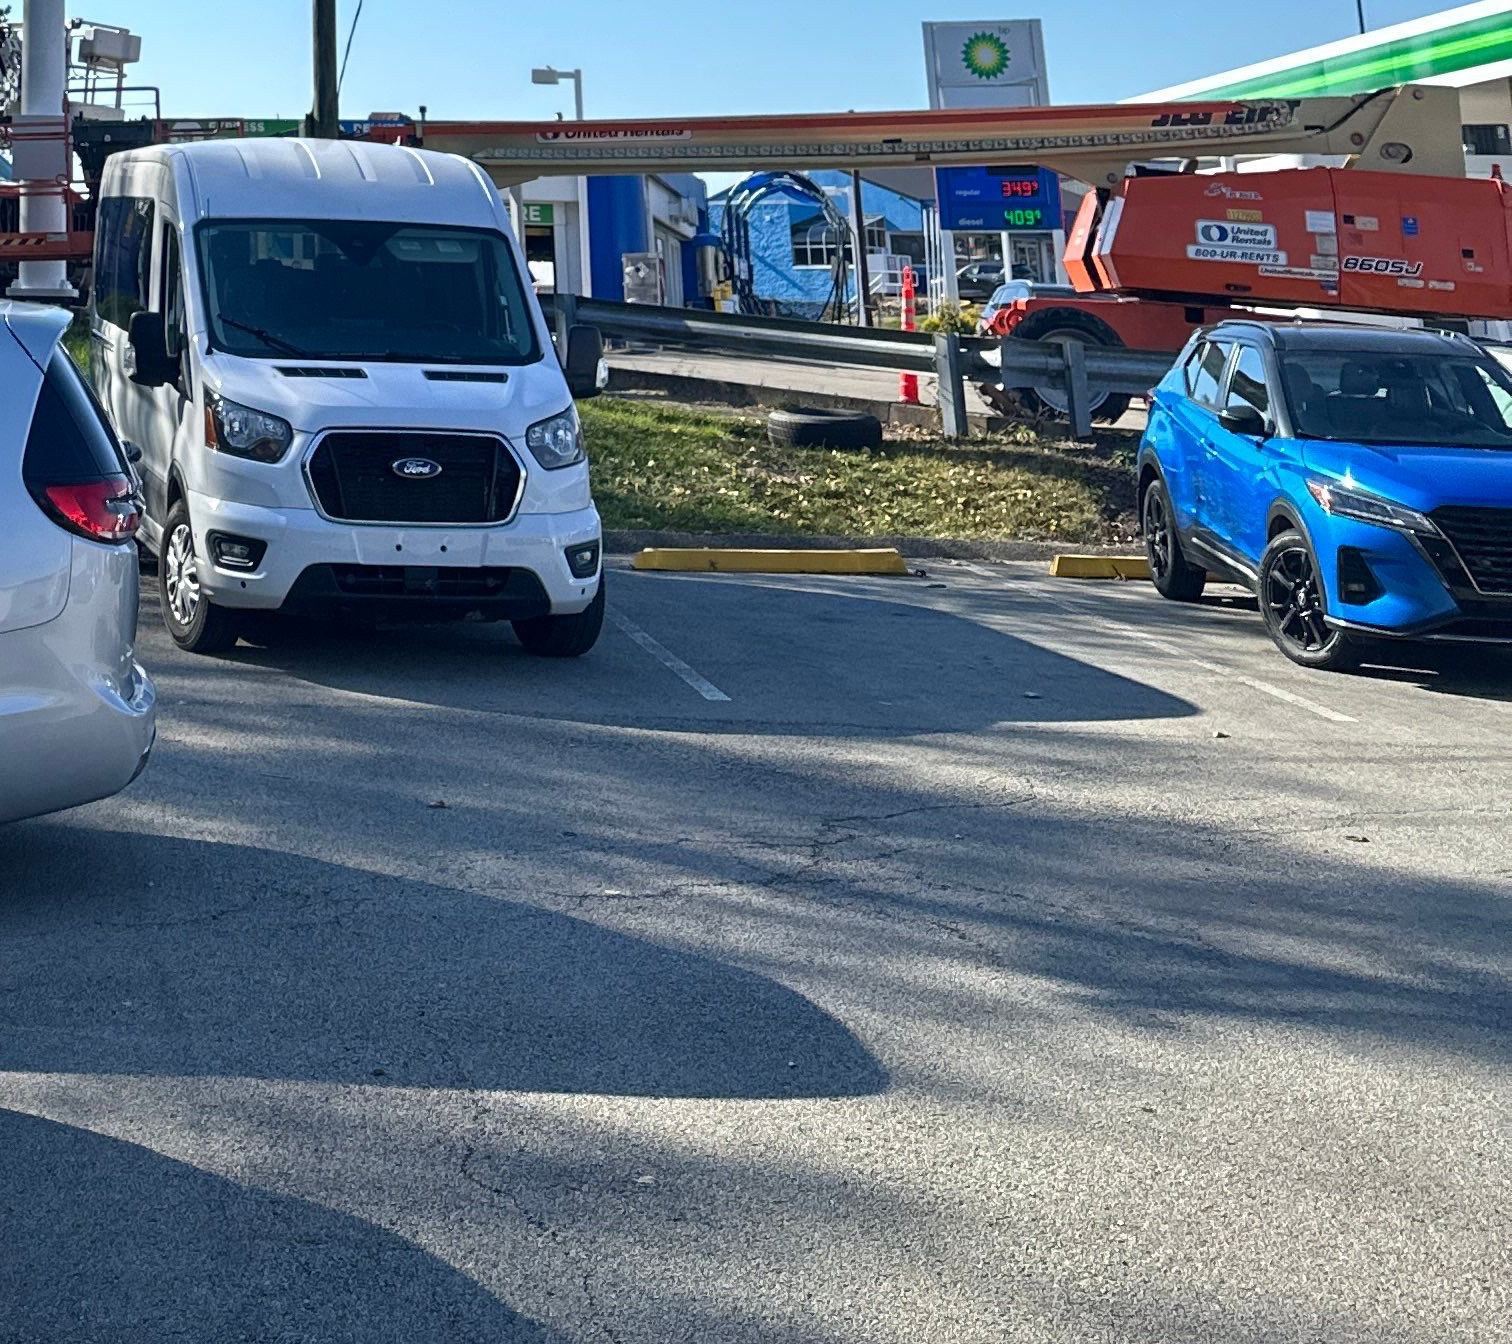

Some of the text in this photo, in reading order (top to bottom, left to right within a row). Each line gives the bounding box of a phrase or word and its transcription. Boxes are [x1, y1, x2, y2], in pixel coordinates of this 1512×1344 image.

[520, 205, 542, 222] RE
[1230, 225, 1270, 236] United
[1231, 235, 1272, 247] Rentals
[1194, 247, 1280, 263] 800-UR-RENTS
[403, 460, 431, 474] Ford
